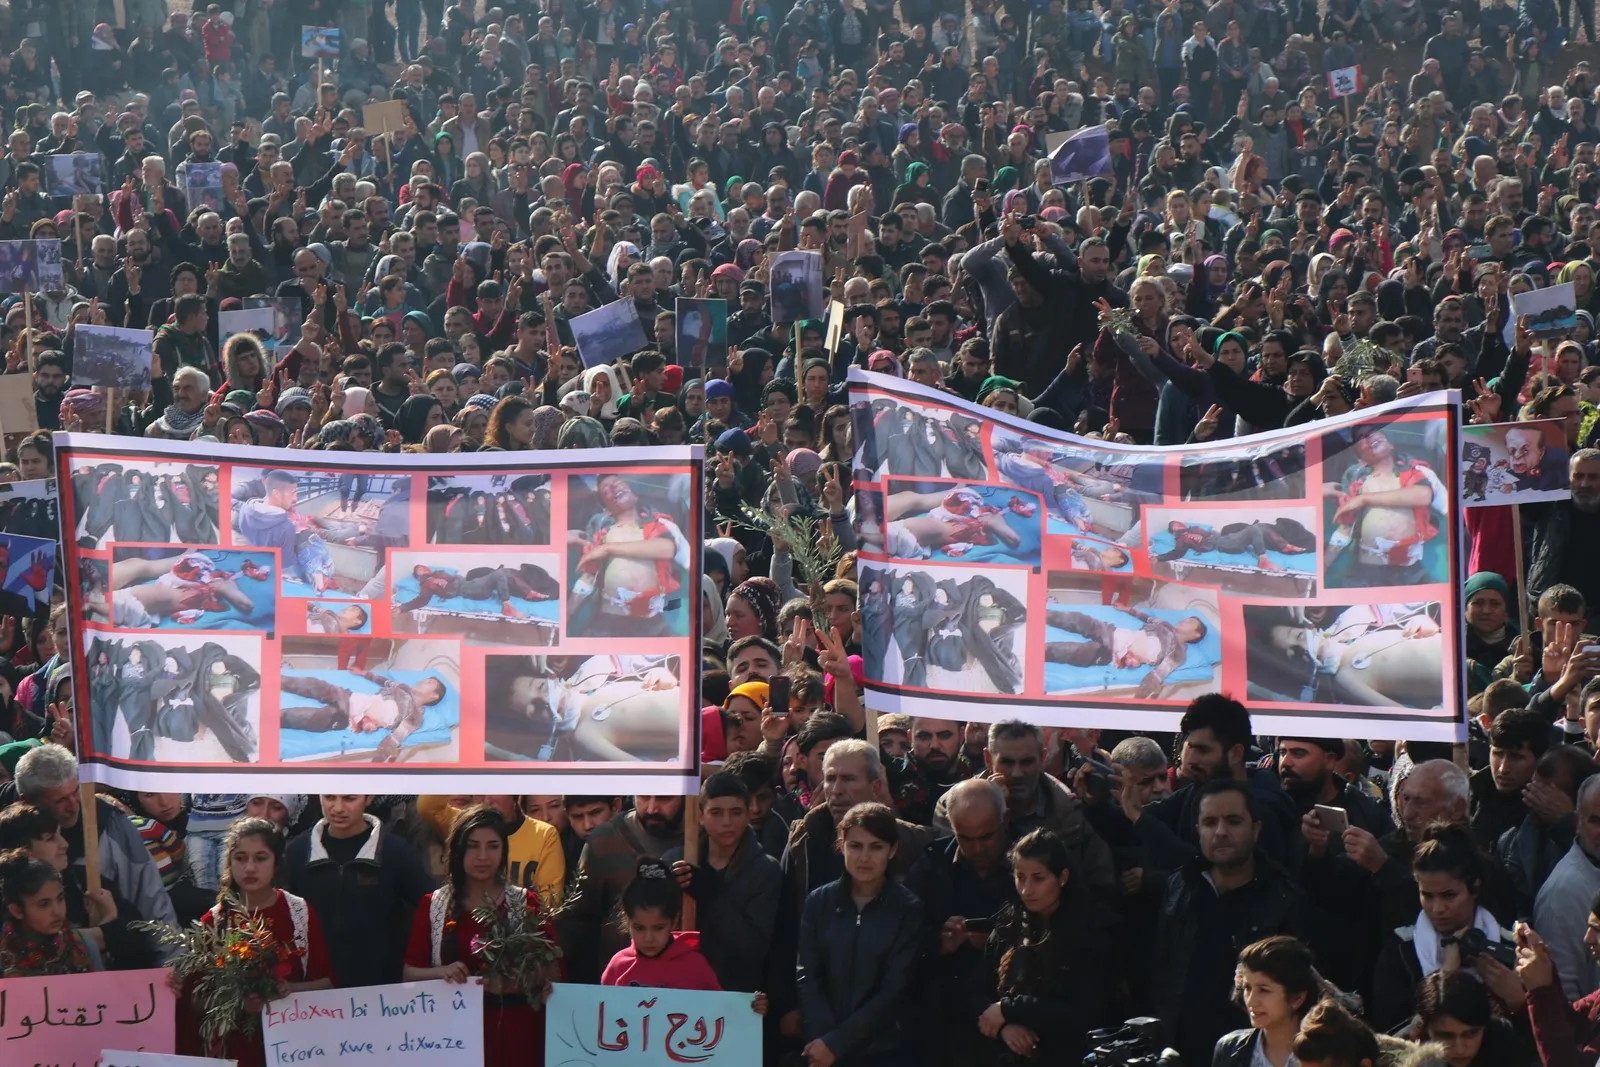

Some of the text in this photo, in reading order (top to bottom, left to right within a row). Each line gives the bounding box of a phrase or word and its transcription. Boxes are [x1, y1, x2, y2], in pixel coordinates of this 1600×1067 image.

[0, 983, 156, 1040] لا تقتلوا
[351, 996, 368, 1019] bi
[452, 990, 467, 1011] û
[597, 997, 725, 1064] روج آفا
[270, 1040, 326, 1066] Terora
